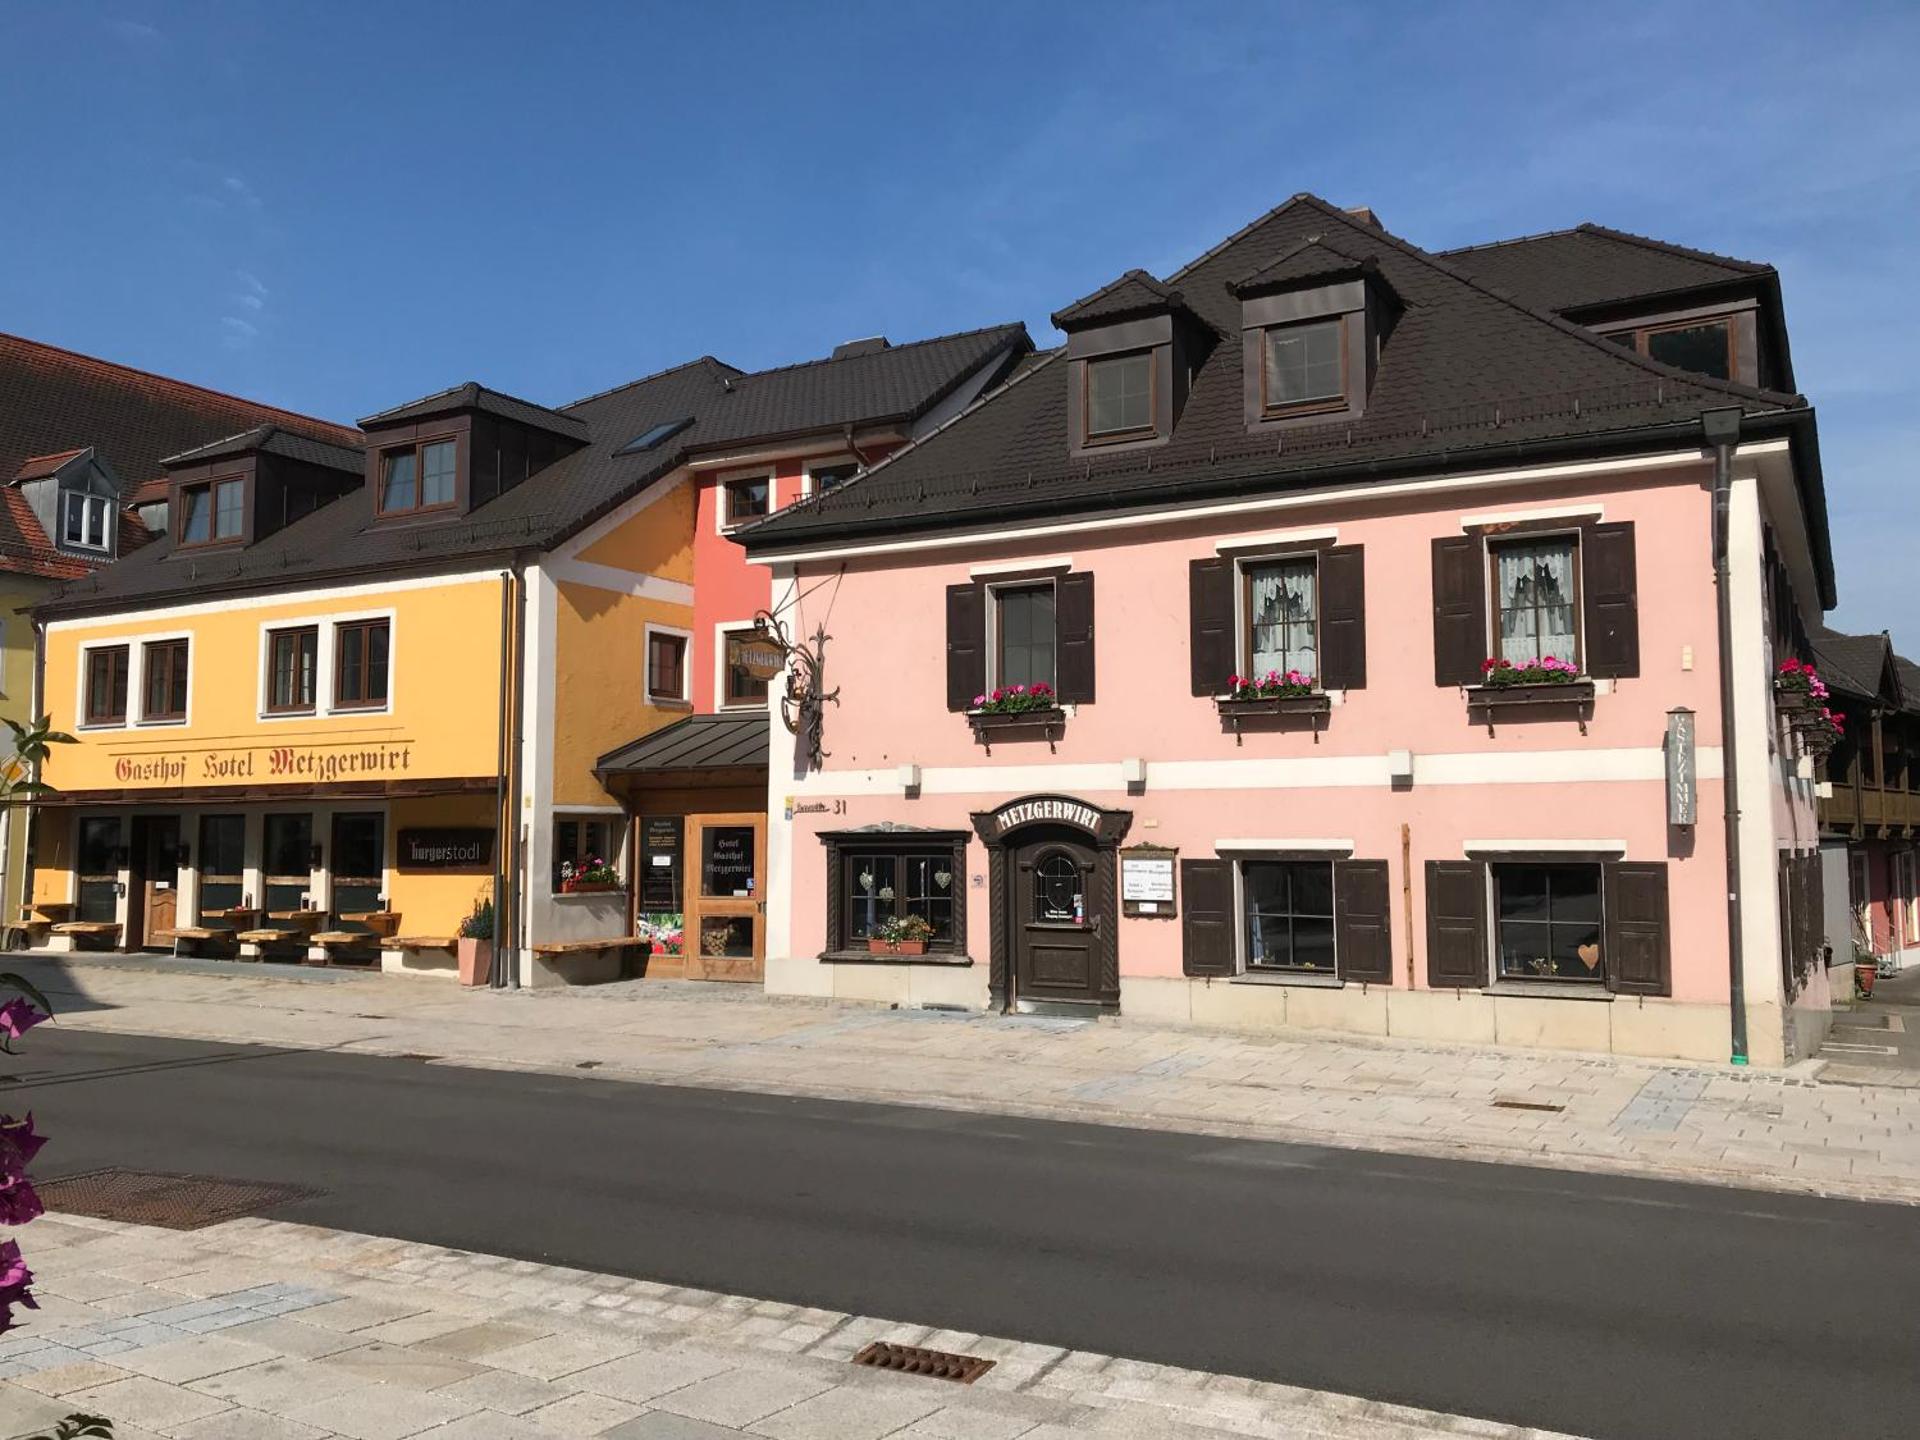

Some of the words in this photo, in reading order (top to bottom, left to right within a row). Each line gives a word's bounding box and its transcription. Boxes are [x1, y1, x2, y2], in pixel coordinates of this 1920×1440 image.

[114, 756, 187, 784] Gasthof
[202, 751, 254, 779] Hotel
[269, 745, 410, 781] Metzgerwirt
[832, 799, 847, 816] 31
[997, 800, 1101, 830] METZGERWIRT
